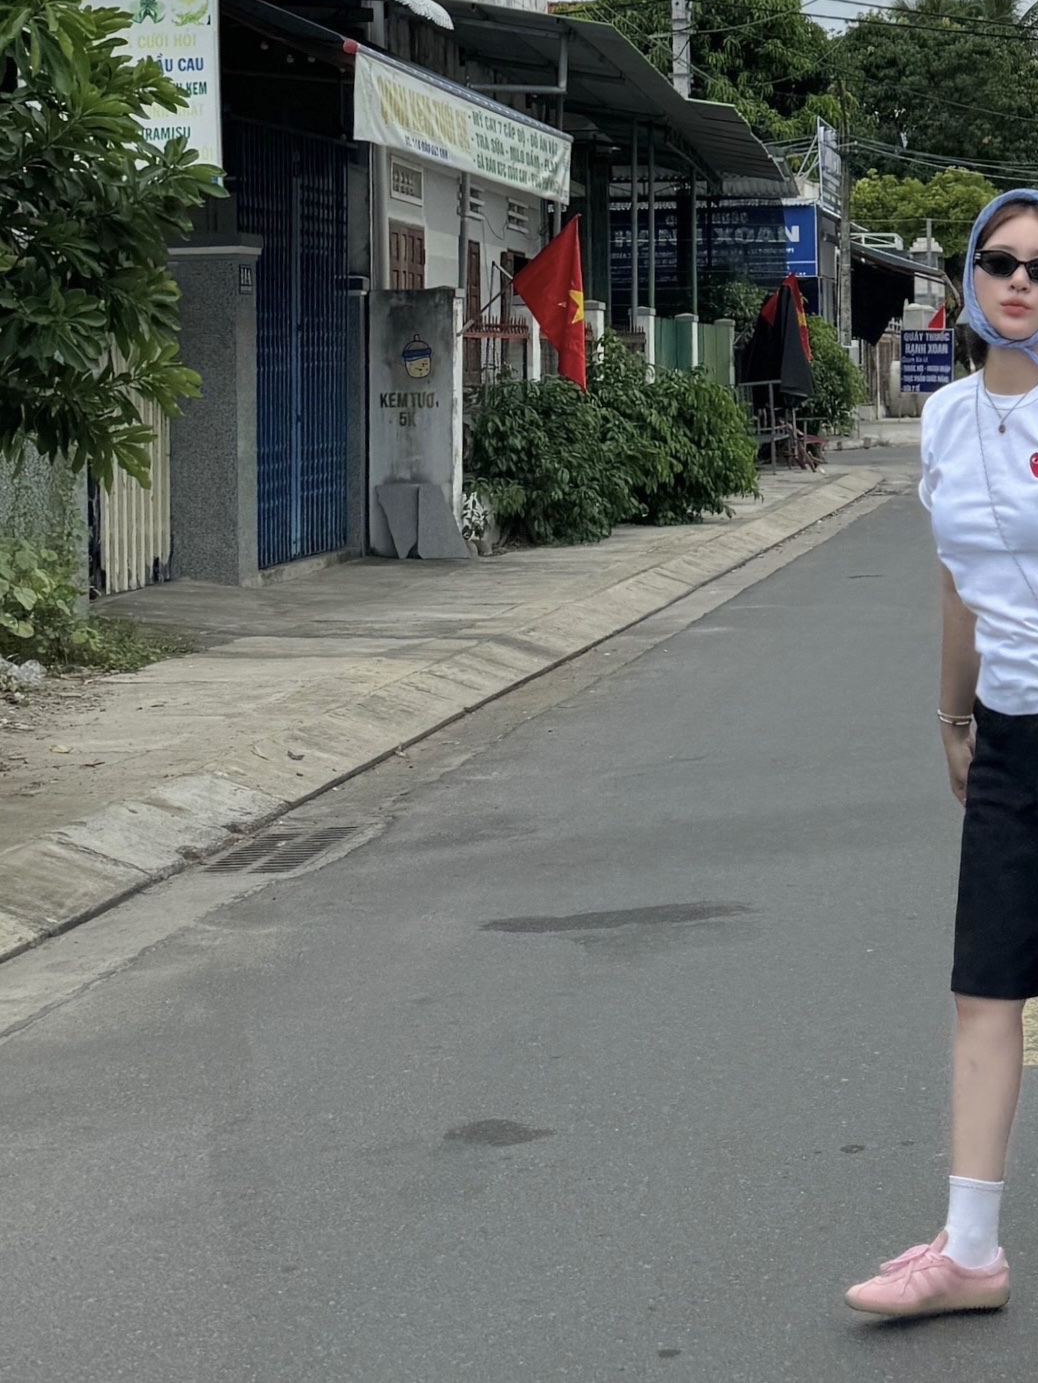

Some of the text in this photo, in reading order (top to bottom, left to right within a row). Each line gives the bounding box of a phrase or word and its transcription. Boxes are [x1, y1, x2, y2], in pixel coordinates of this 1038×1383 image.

[178, 57, 204, 72] CAU
[142, 126, 191, 141] RAMISU
[714, 225, 800, 245] XOAN
[380, 392, 408, 408] KEM
[399, 412, 416, 427] 5K
